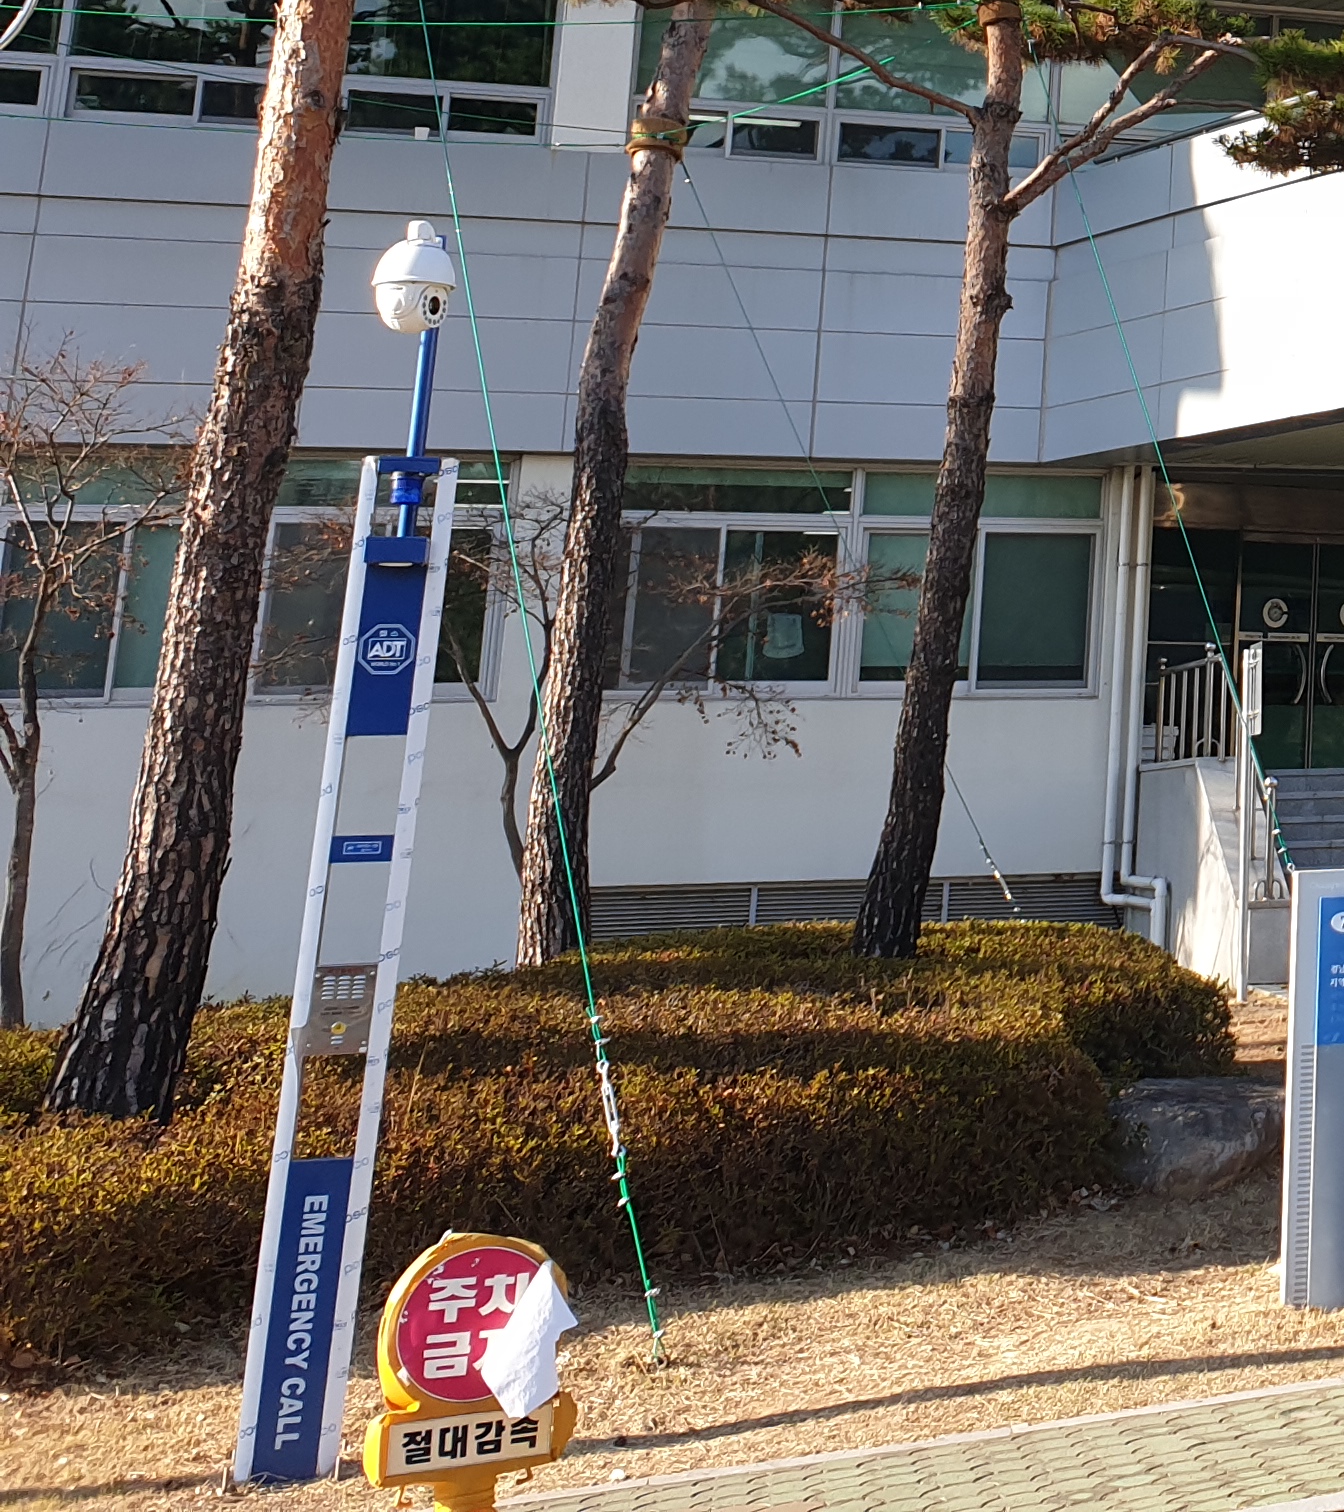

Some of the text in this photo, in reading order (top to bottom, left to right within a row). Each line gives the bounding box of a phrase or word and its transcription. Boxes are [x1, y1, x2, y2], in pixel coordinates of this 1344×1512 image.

[368, 640, 407, 658] ADT
[273, 1193, 330, 1451] EMERGENCY CALL
[422, 1328, 503, 1380] 금
[401, 1416, 540, 1466] 절대감속
